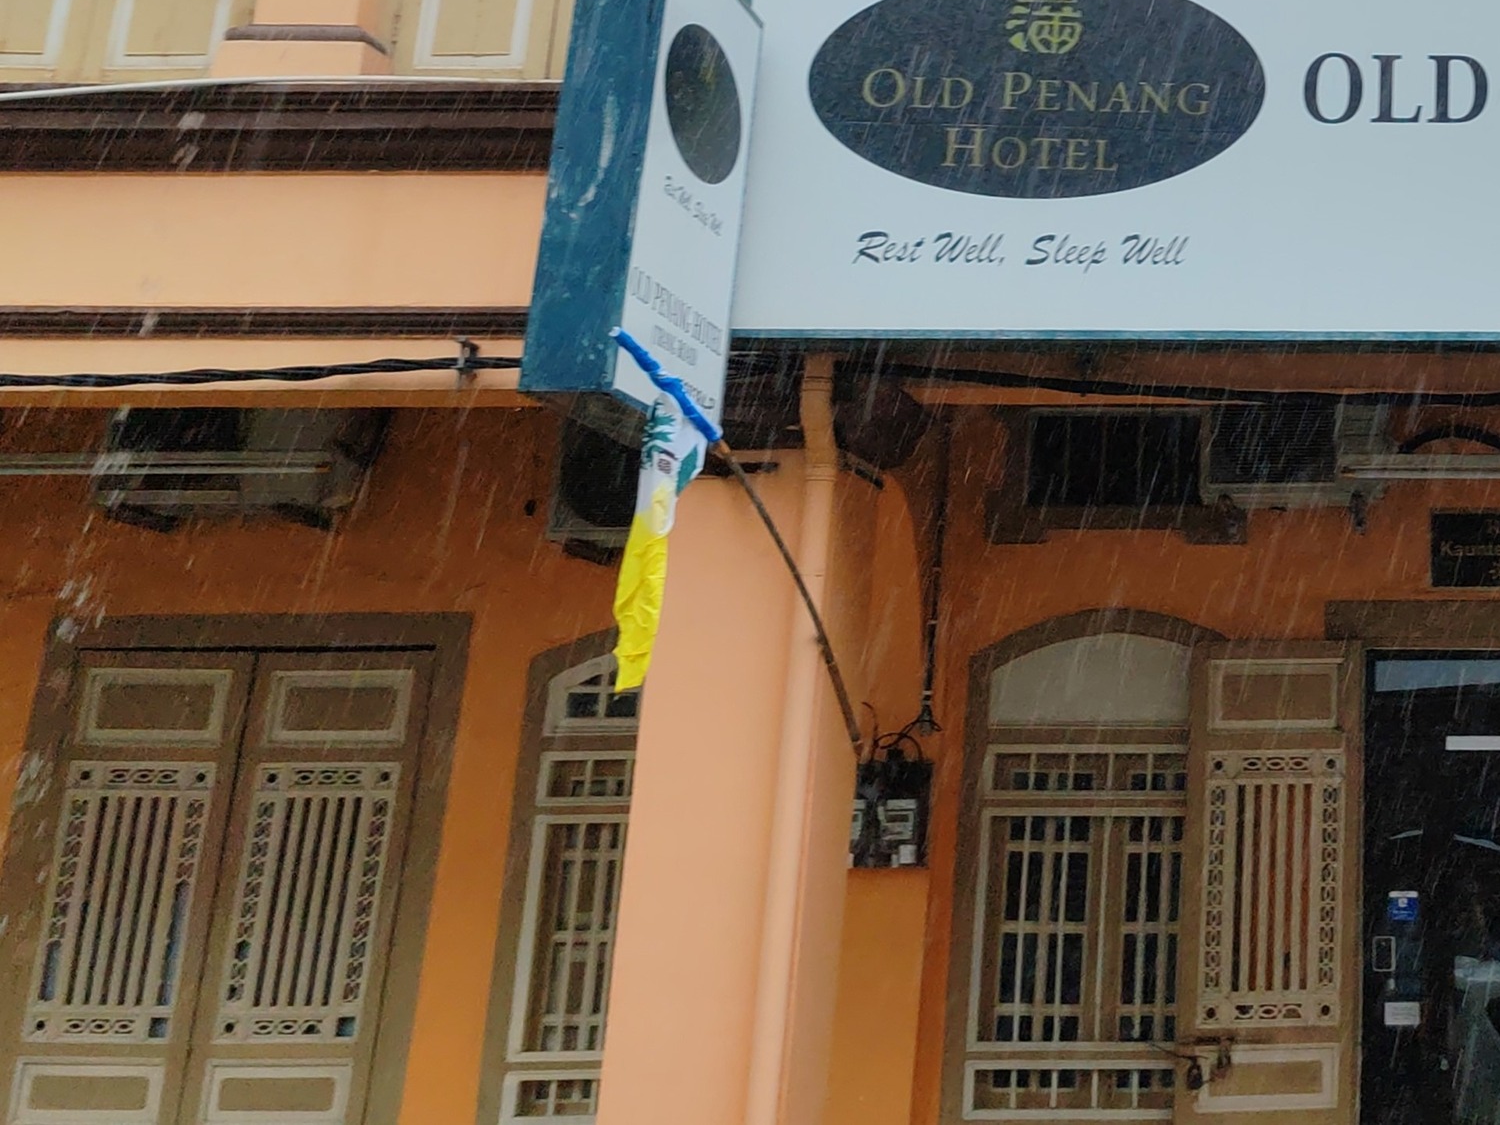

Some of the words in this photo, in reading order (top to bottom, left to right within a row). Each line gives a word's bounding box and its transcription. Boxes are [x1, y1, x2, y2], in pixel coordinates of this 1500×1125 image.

[1303, 52, 1489, 125] OLD
[853, 231, 924, 265] Rest
[934, 231, 1005, 266] Well,
[1025, 233, 1107, 273] Sleep
[1120, 234, 1190, 266] Well
